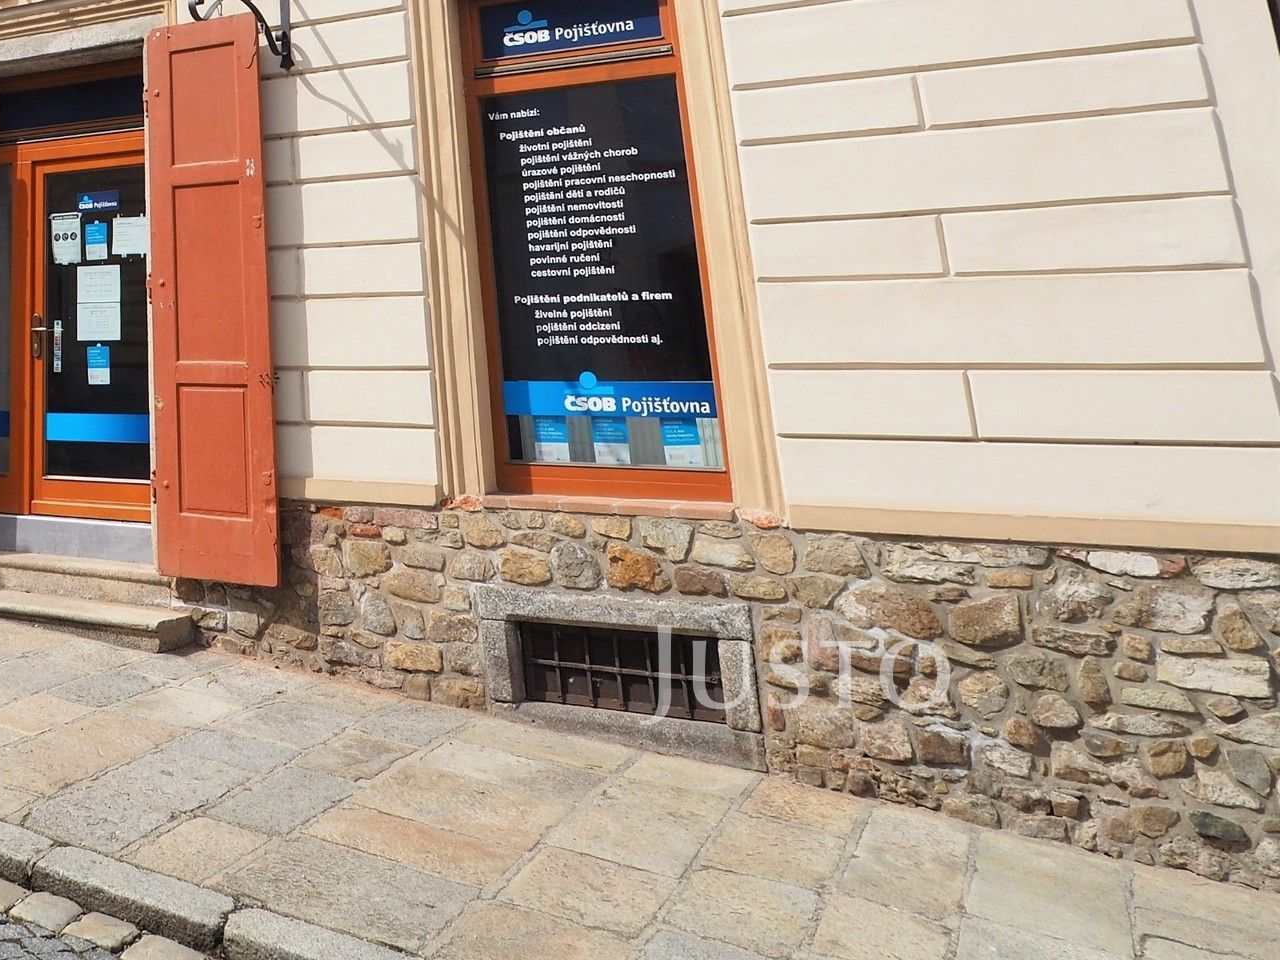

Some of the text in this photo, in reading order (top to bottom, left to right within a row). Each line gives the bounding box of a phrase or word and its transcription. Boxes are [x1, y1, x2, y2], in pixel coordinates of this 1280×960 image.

[503, 19, 635, 47] ČSOB Pojišťovna
[488, 108, 540, 121] Vám nabízí:
[499, 123, 586, 141] Pojištění občanů
[519, 138, 592, 152] životní pojištění
[520, 147, 638, 166] pojištění vážných chorob
[522, 162, 601, 177] úrazové pojištění
[522, 169, 676, 191] pojištění pracovní neschopnosti
[524, 190, 564, 203] pojištění
[585, 190, 592, 198] a
[594, 186, 625, 196] rodičů
[525, 199, 624, 215] pojištění nemovitostí
[526, 212, 625, 228] pojištění domácností
[528, 225, 636, 241] pojištění odpovědnosti
[528, 239, 612, 253] havarijní pojištění
[530, 252, 600, 266] povinné ručení
[531, 265, 615, 278] cestovní pojištění
[514, 291, 673, 306] Pojištění podnikatelů a firem
[570, 308, 612, 320] pojištění
[536, 321, 621, 334] pojištění odcizení
[537, 333, 664, 346] pojištění odpovědnosti aj.
[564, 395, 711, 417] ČSOB Pojišťovna
